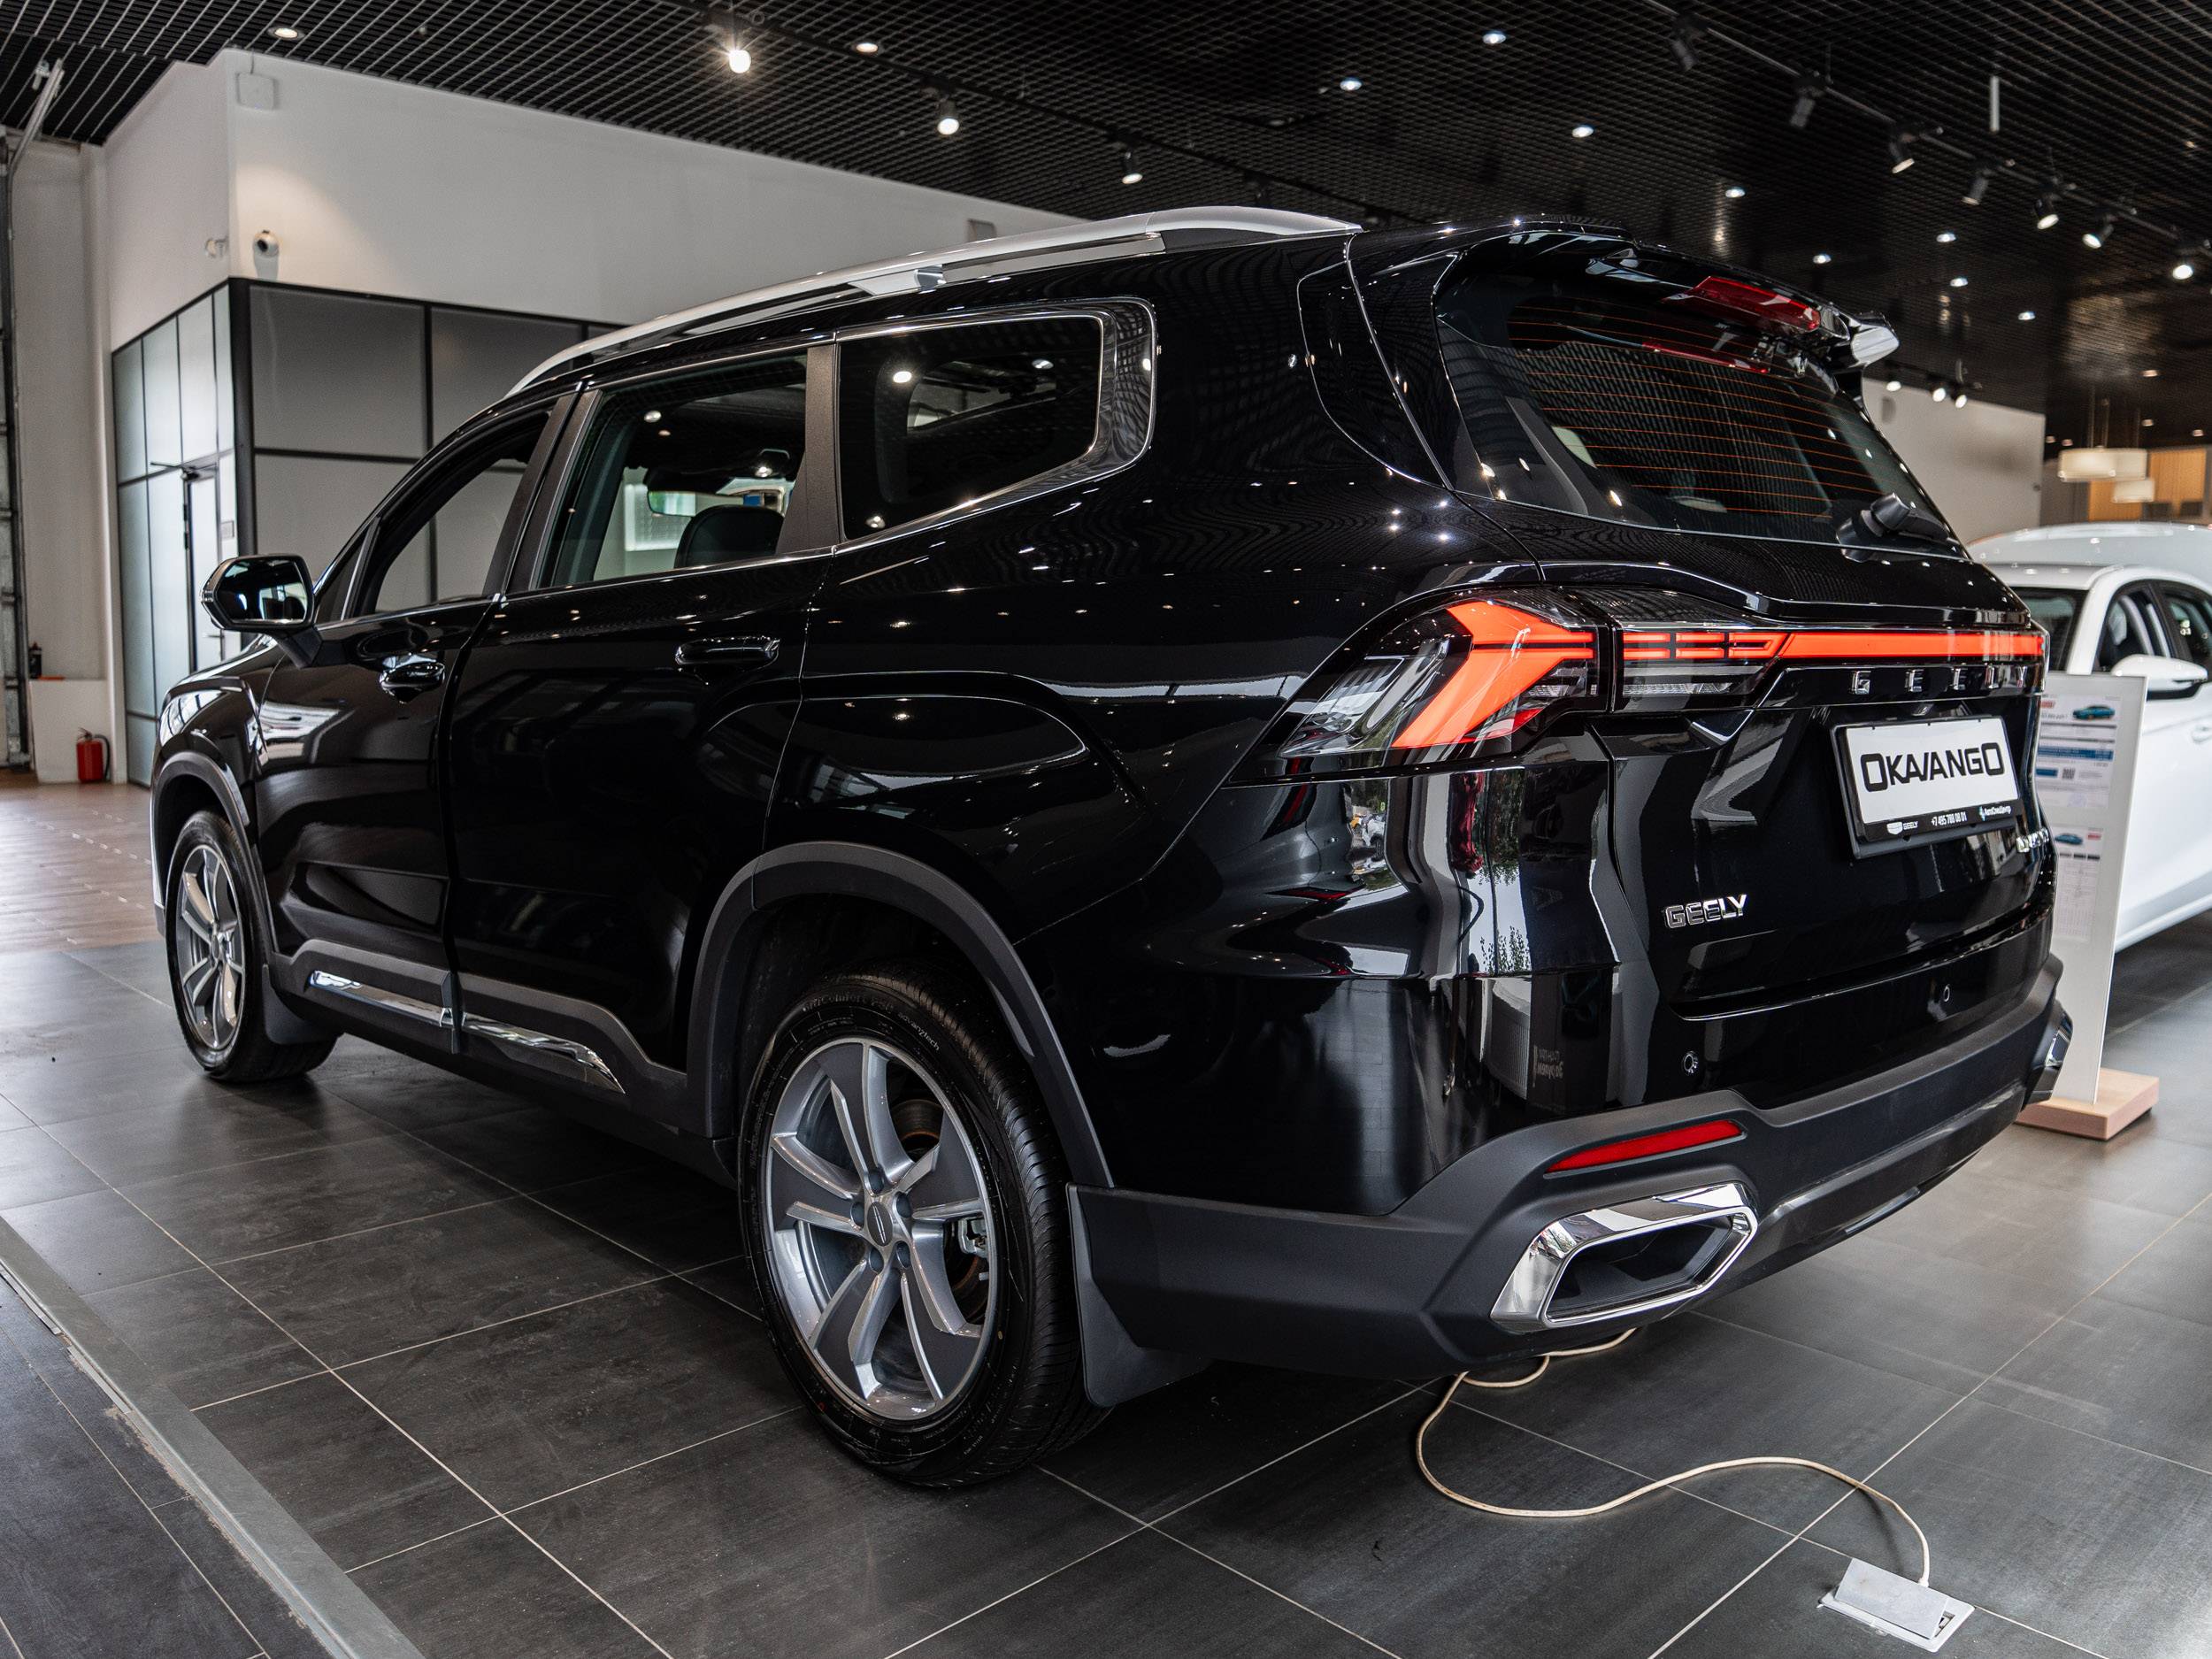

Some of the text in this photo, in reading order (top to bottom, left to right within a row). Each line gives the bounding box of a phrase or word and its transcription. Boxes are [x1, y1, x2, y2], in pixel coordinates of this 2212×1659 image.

[1853, 665, 2027, 695] GEELY
[1860, 742, 2005, 792] OKAVANGO
[1902, 821, 1918, 830] GEELY
[1663, 894, 1747, 928] GEELY
